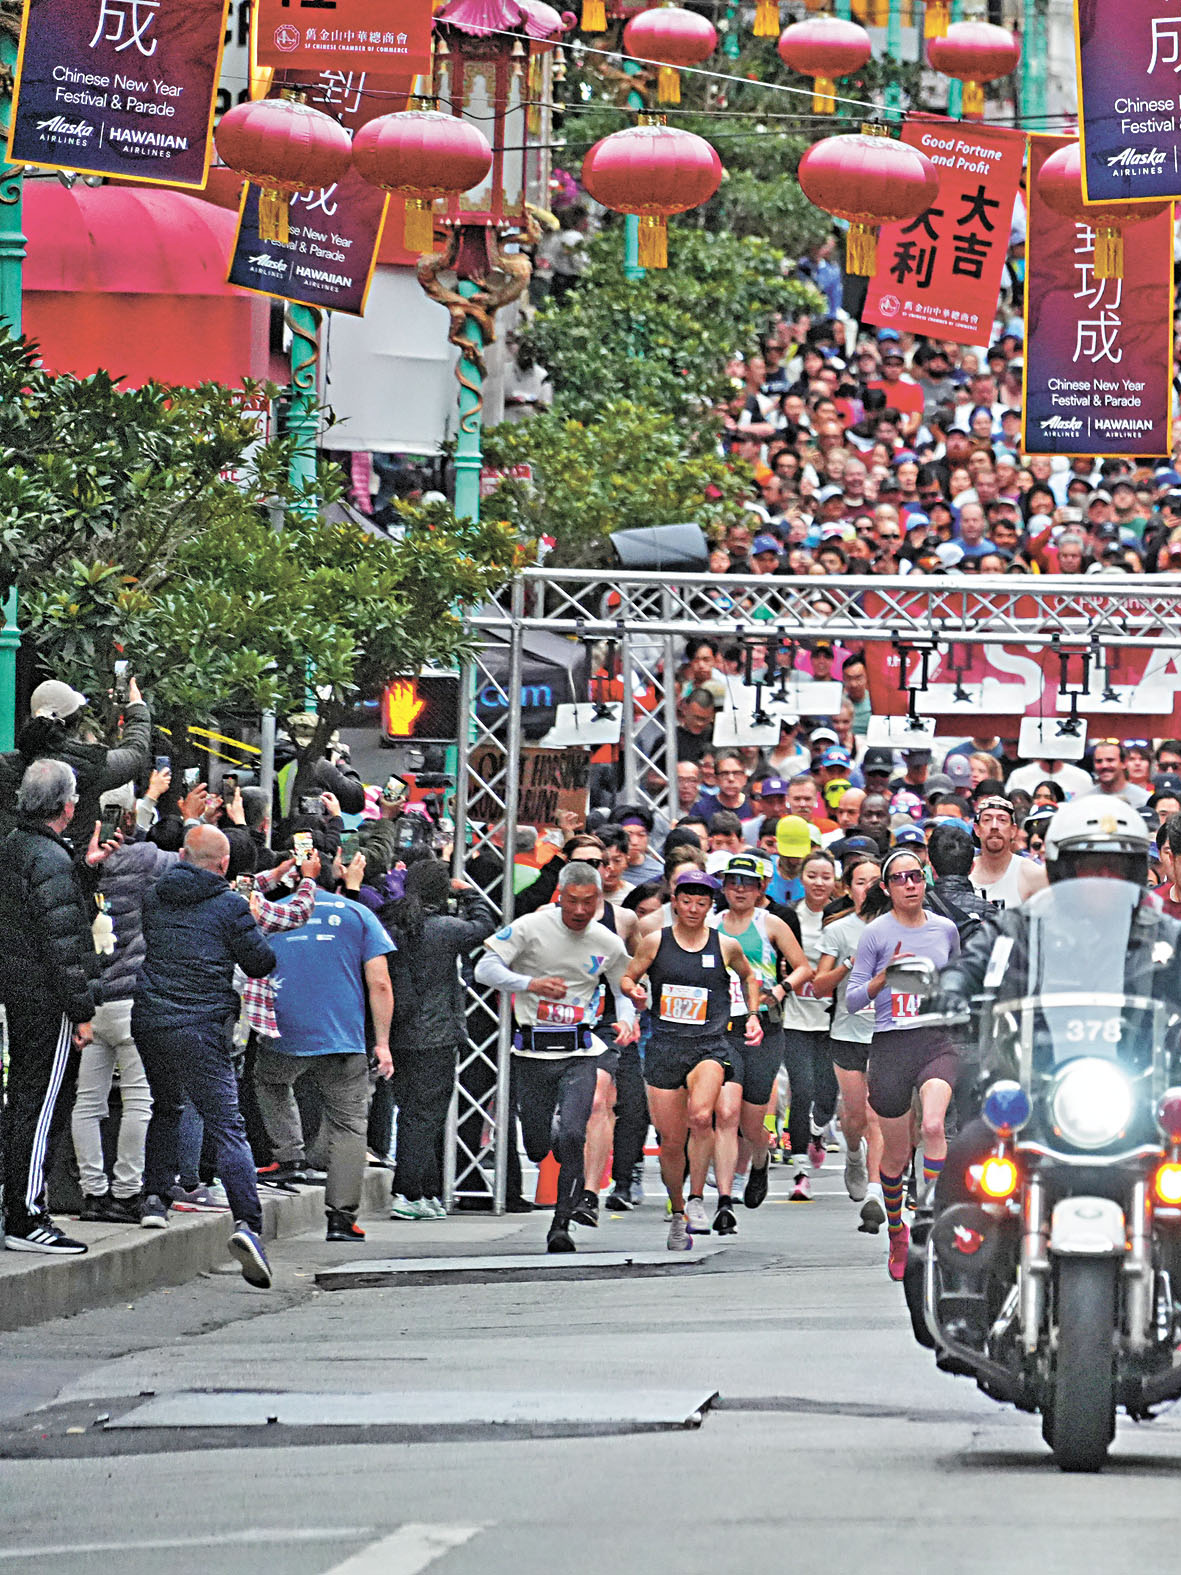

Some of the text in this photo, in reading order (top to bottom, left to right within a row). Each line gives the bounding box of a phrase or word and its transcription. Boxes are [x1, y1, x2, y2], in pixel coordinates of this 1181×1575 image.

[53, 66, 183, 97] Chinese New Year
[56, 87, 175, 117] Festival & Parade
[1114, 98, 1174, 114] Chinese
[36, 115, 188, 150] Alaska HAWAIIAN
[1121, 118, 1175, 134] Festival
[39, 135, 171, 158] AIRLINES AIRLINES
[921, 133, 1003, 161] Good Fortune
[1107, 148, 1167, 167] Alaska
[930, 154, 990, 176] and Profit
[1112, 167, 1163, 177] AIRLINES
[302, 226, 328, 243] New
[330, 232, 353, 249] Year
[951, 184, 1000, 280] 大吉
[299, 241, 309, 254] &
[309, 243, 345, 263] Parade
[248, 254, 352, 288] Alaska HAWAIIAN
[250, 266, 339, 293] AIRLINES AIRLINES
[1048, 378, 1145, 392] Chinese New Year
[1052, 394, 1141, 407] Festival & Parade
[1040, 415, 1153, 431] Alaska HAWAIIAN
[1105, 431, 1142, 439] AIRLINES
[665, 995, 704, 1020] 1827
[1066, 1019, 1122, 1042] 378
